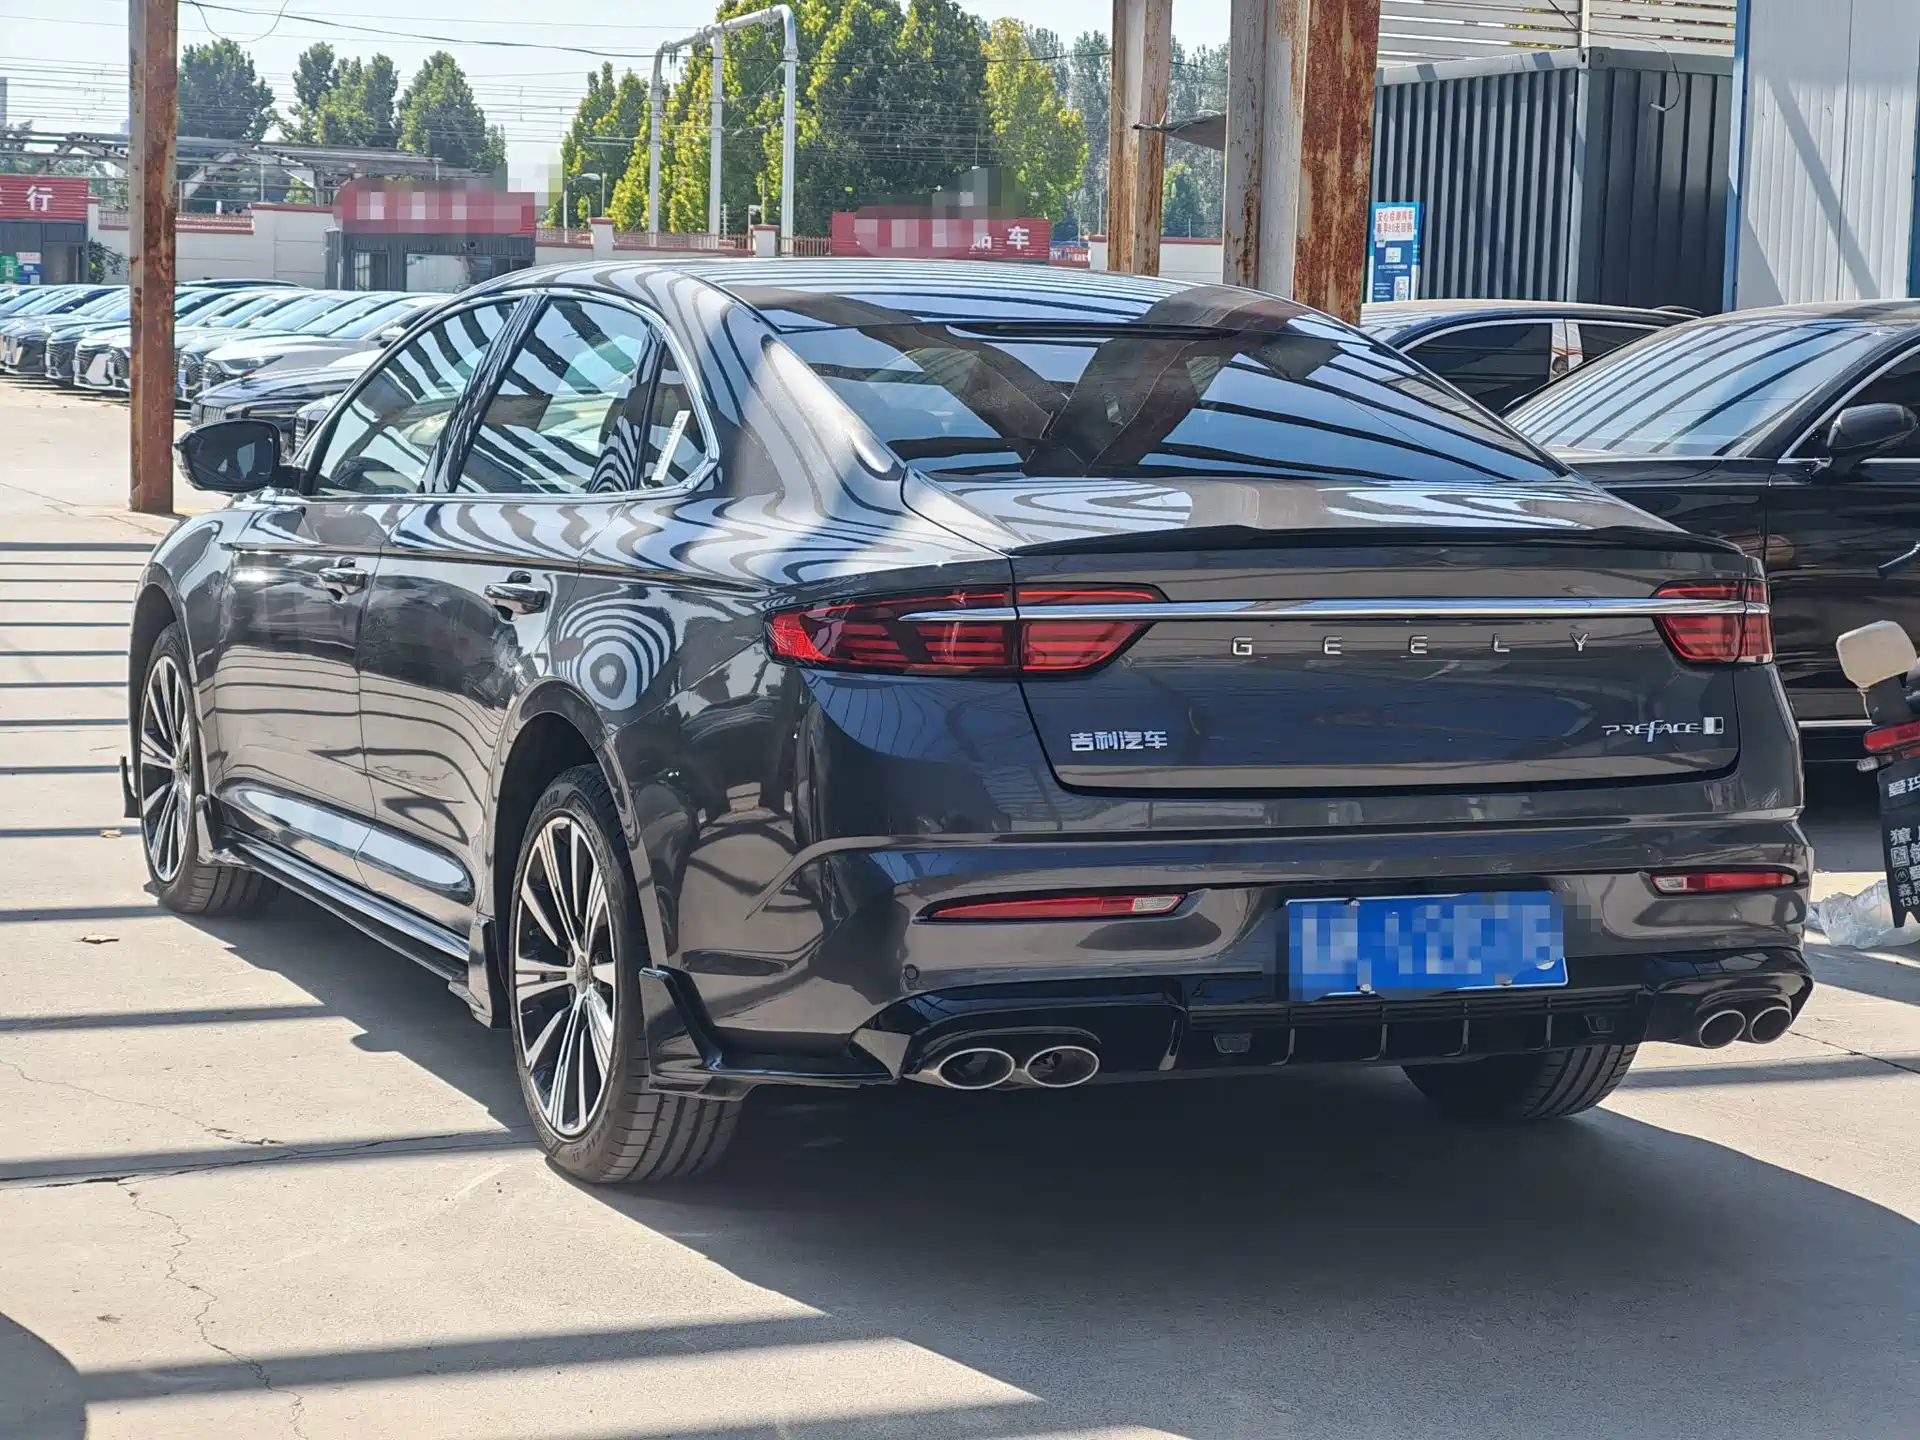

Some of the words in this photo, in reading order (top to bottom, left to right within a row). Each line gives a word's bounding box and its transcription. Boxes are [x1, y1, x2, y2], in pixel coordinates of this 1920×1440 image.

[1231, 632, 1590, 656] GEELY
[1070, 730, 1168, 752] 吉利汽车
[1600, 719, 1702, 743] PREFACE
